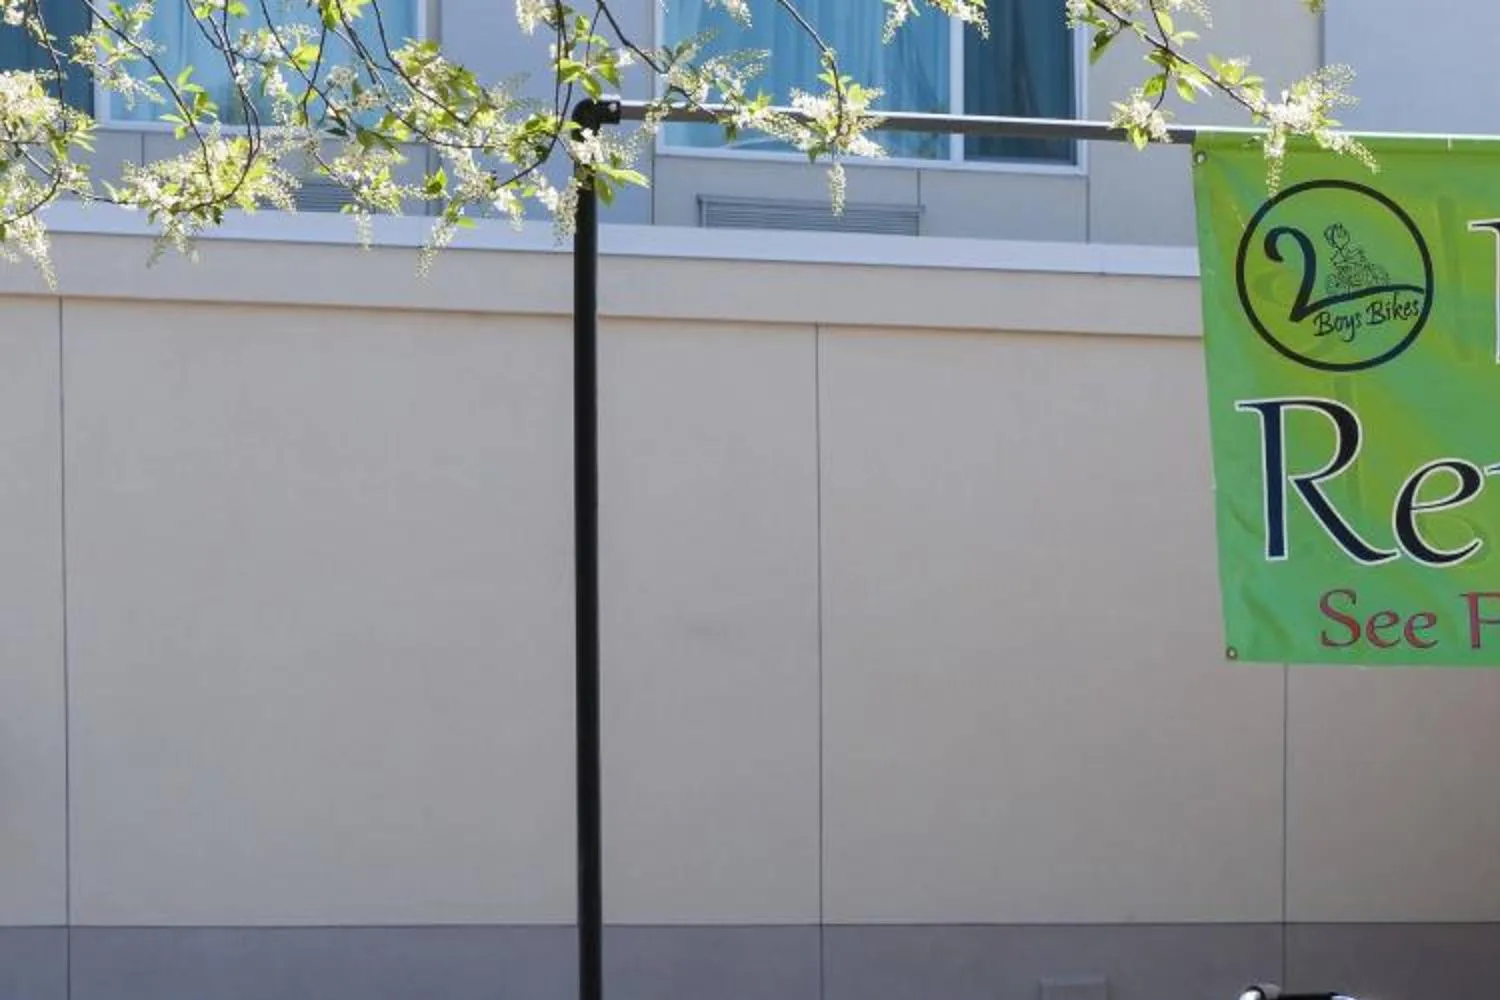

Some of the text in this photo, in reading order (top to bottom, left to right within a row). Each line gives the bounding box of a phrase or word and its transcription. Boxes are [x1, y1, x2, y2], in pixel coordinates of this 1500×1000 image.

[1313, 292, 1420, 343] Boys Bikes
[1319, 587, 1438, 650] See
